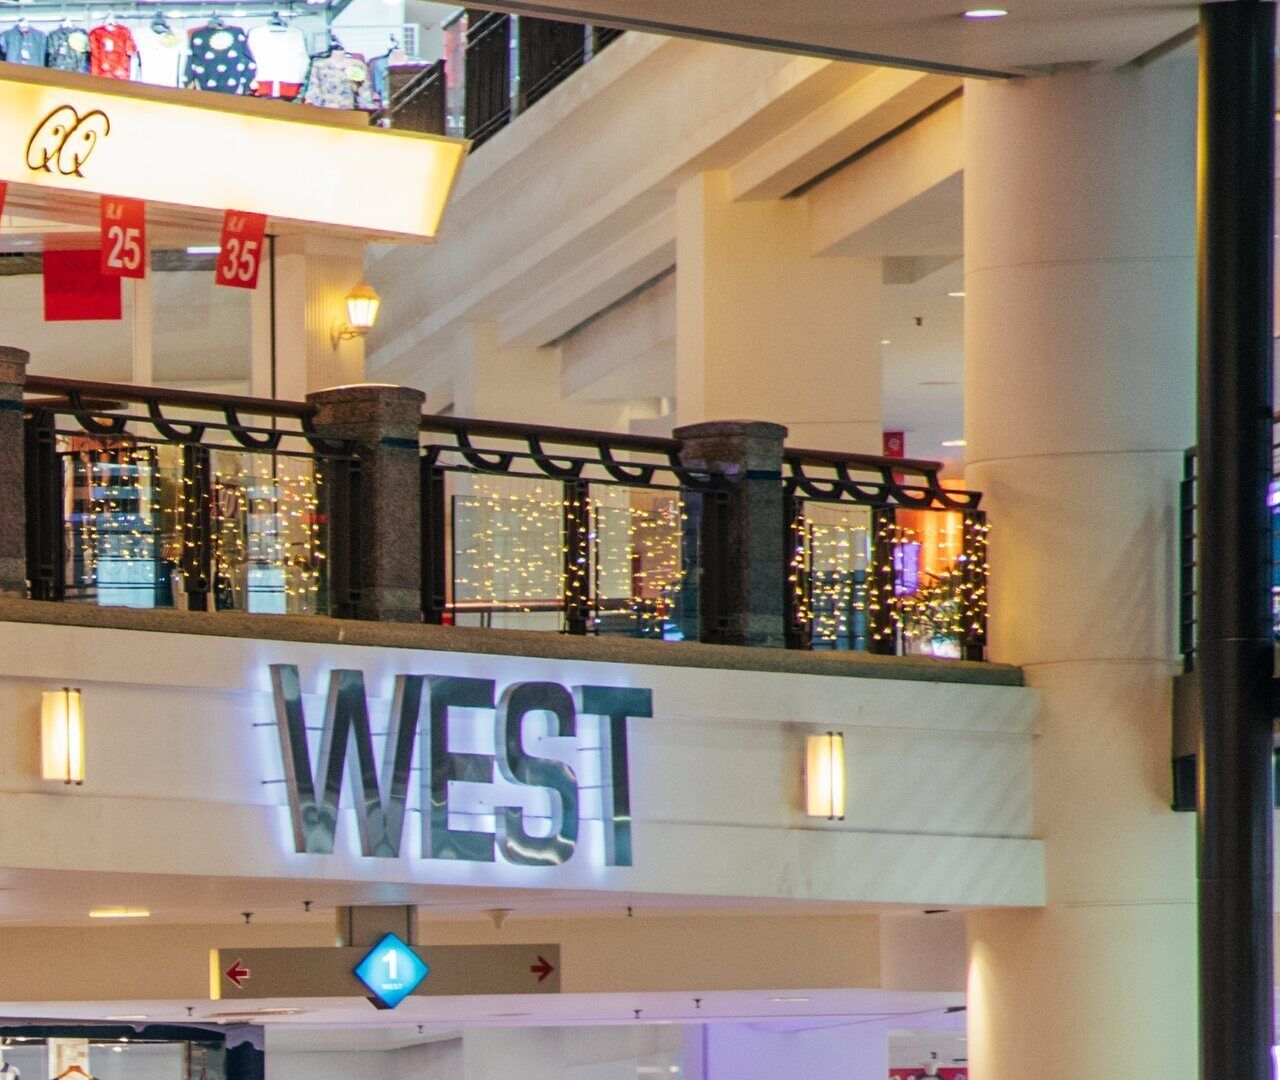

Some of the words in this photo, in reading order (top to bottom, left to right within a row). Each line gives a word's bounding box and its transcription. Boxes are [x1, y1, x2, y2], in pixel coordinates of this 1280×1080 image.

[107, 225, 141, 270] 25
[222, 238, 258, 282] 35
[268, 664, 653, 867] WEST
[381, 949, 398, 980] 1
